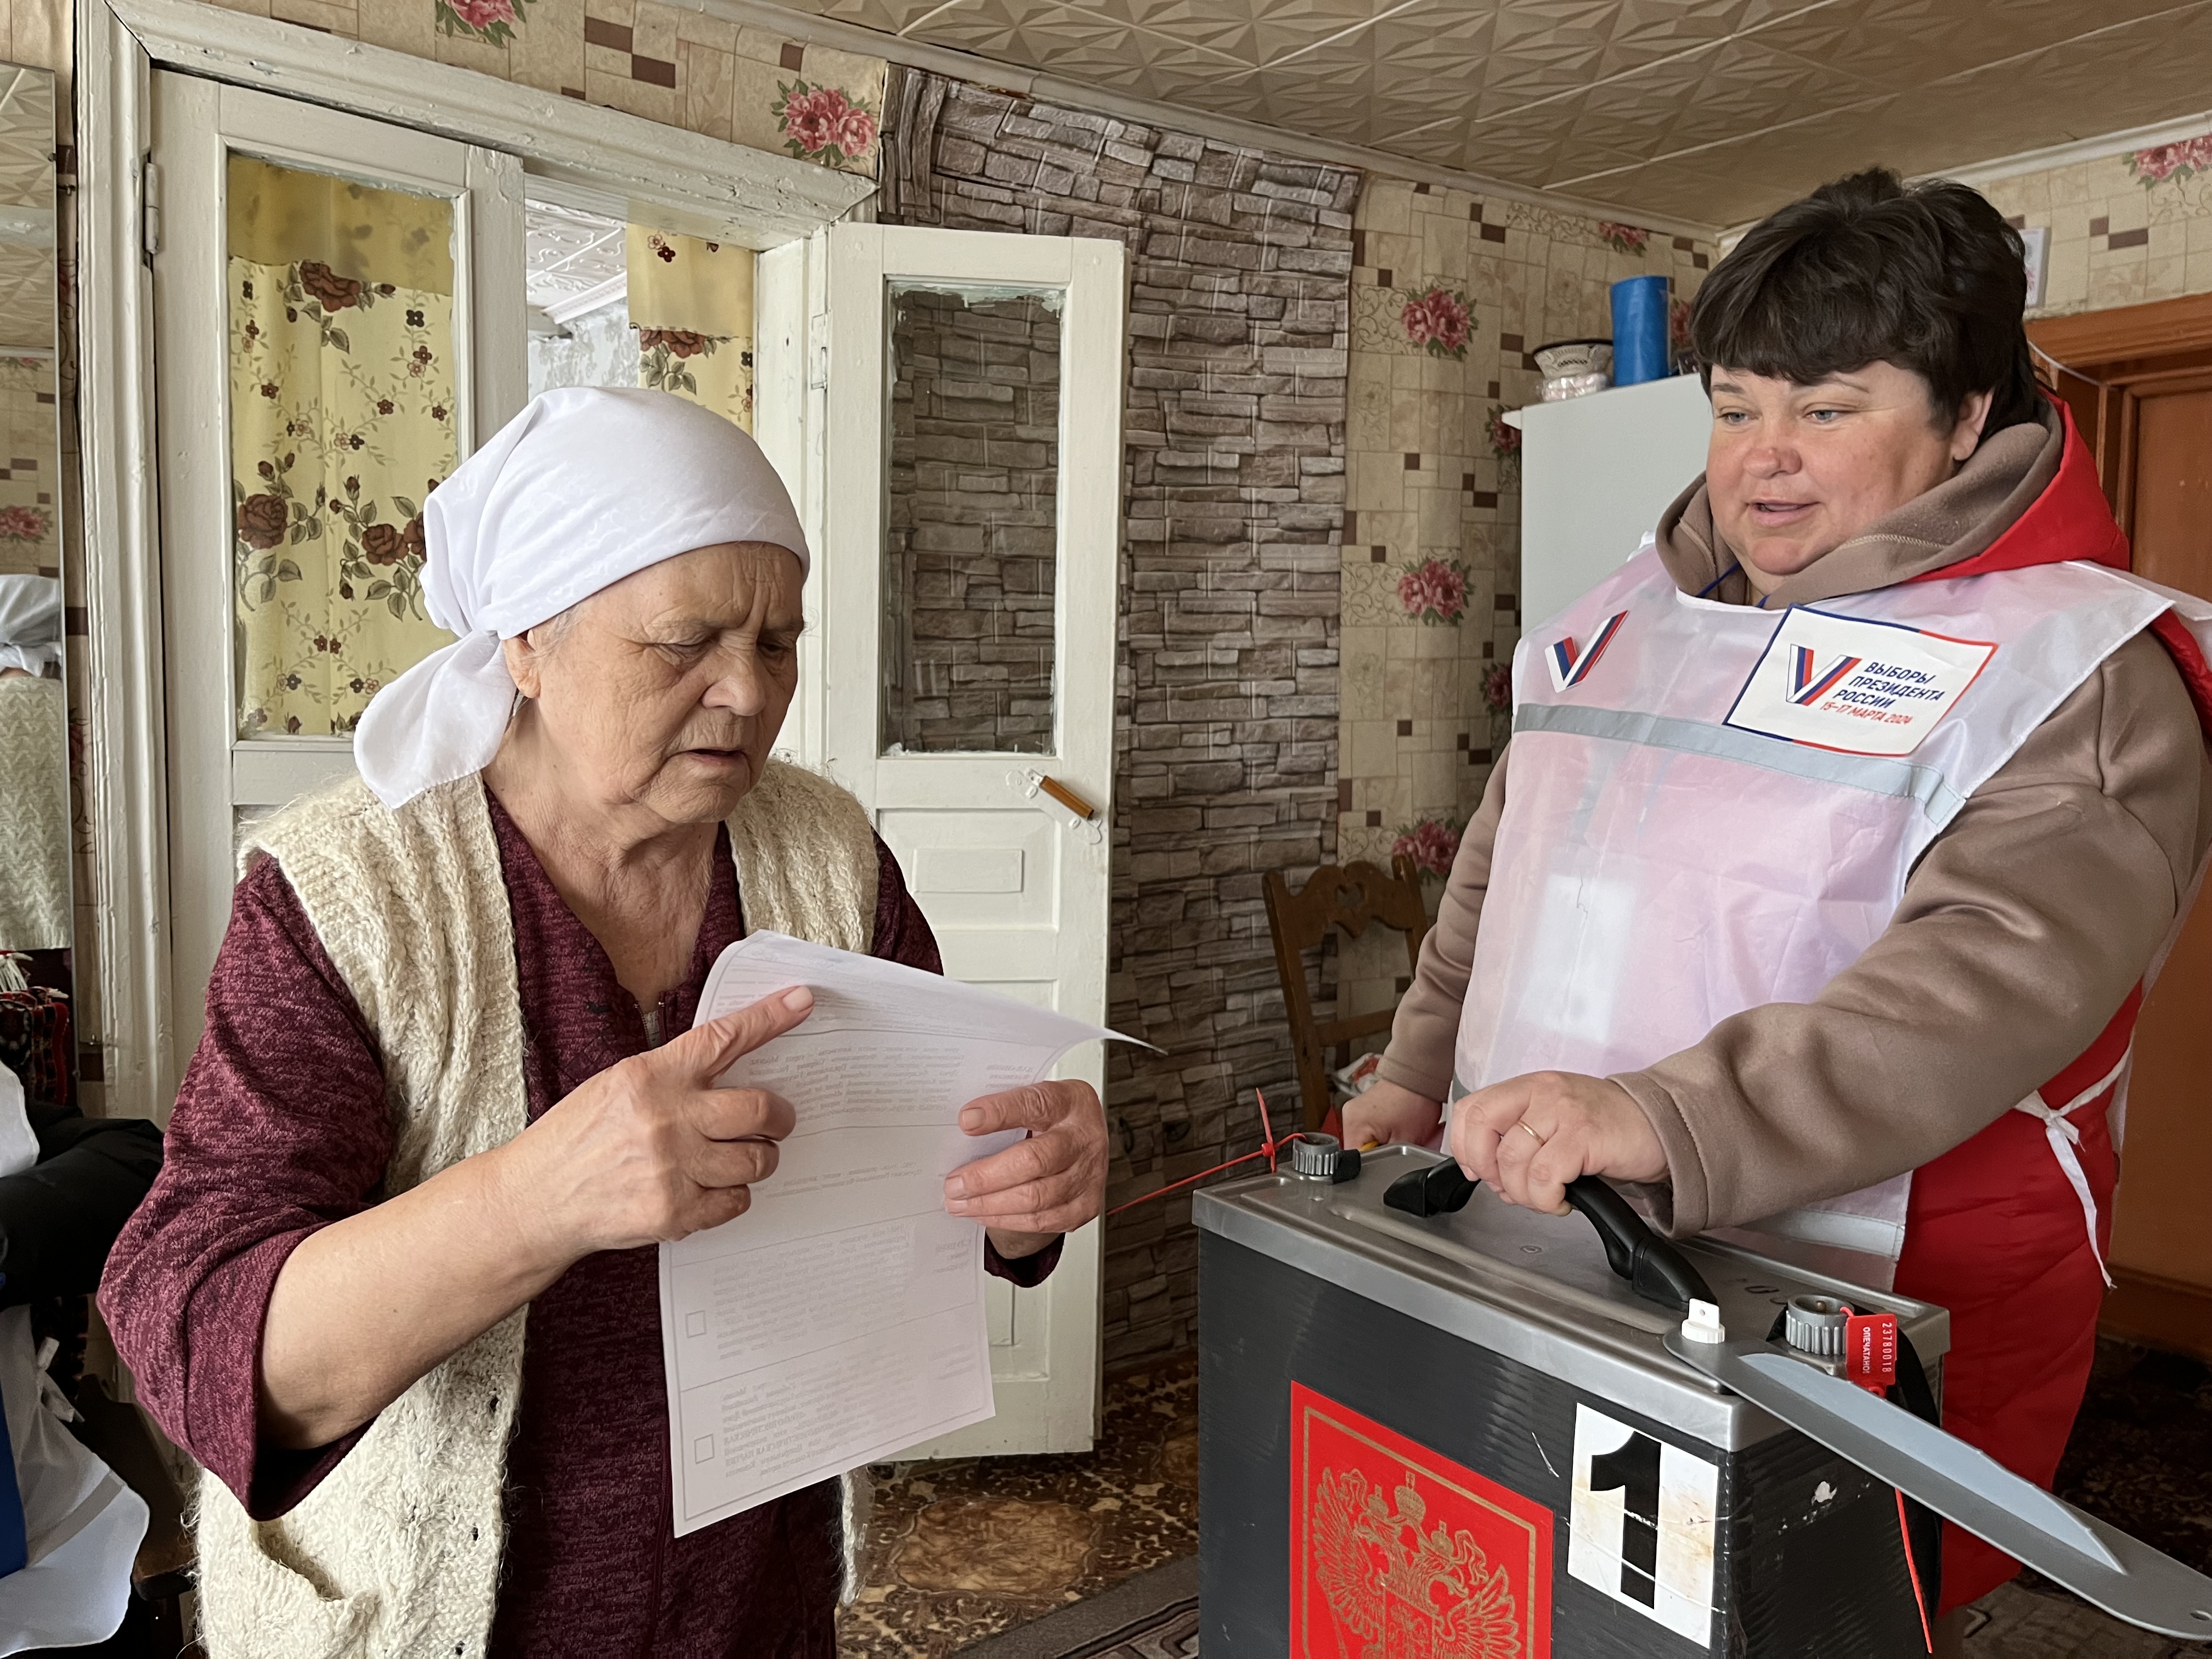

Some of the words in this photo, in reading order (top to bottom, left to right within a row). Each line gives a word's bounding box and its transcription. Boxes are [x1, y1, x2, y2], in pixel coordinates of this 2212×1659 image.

[1864, 662, 1936, 685] ВЫБОРЫ
[1832, 690, 1896, 708] РОССИИ
[1848, 676, 1945, 701] ПРЕЗИДЕНТА
[1848, 706, 1887, 721] МАРТА
[1884, 713, 1914, 724] 2024
[1882, 1322, 1892, 1373] 23780018
[1590, 1431, 1662, 1610] 1
